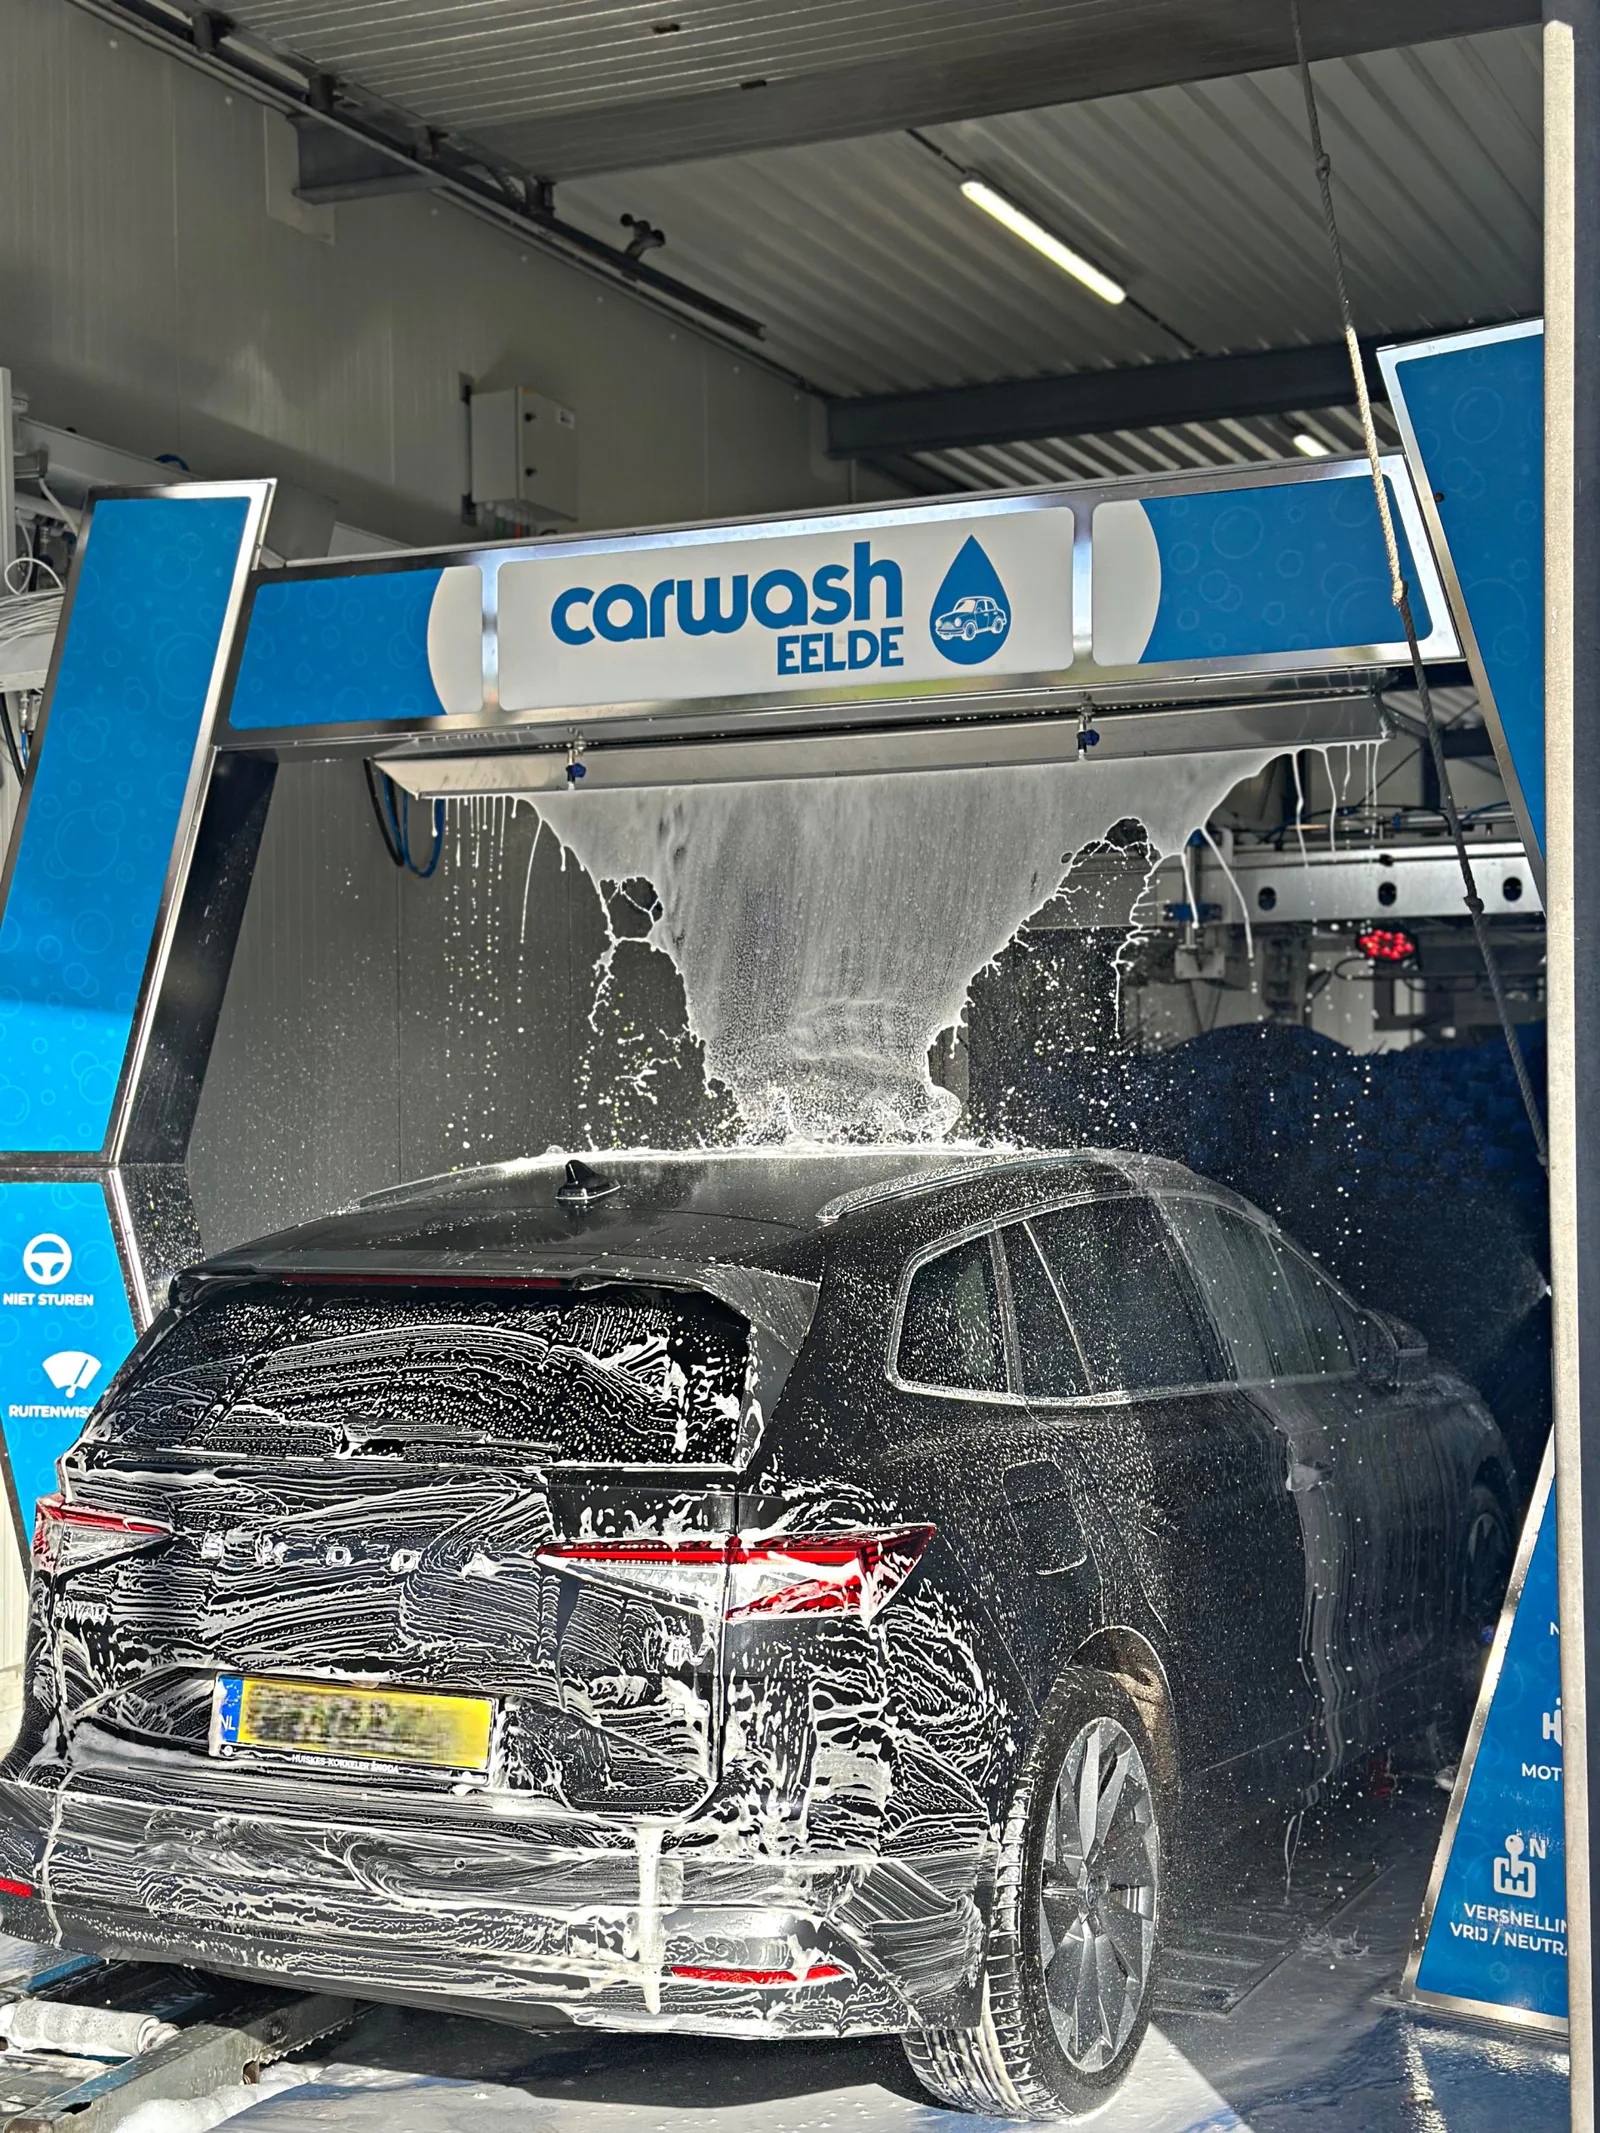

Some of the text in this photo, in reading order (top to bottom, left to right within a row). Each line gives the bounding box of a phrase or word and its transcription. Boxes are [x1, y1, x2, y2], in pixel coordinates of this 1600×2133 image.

[551, 541, 903, 646] carwash
[777, 627, 904, 675] EELDE
[3, 1293, 94, 1307] NIET STUREN
[220, 1714, 236, 1731] NL
[1529, 1838, 1546, 1859] N
[1450, 1921, 1488, 1942] VRIJ
[1504, 1931, 1568, 1956] NEUTR
